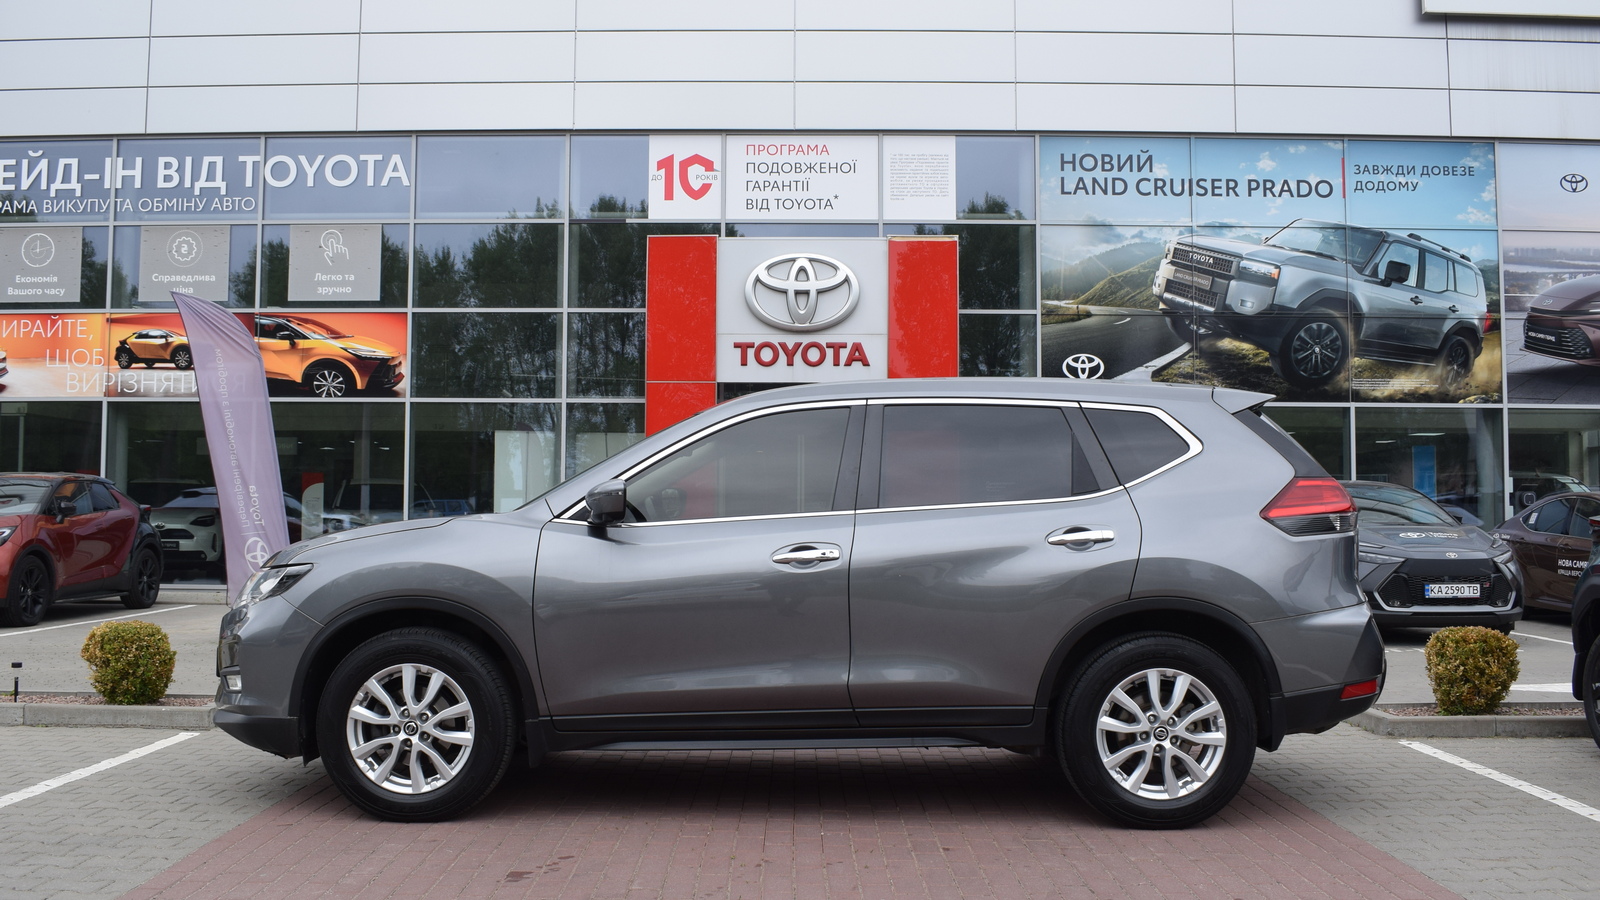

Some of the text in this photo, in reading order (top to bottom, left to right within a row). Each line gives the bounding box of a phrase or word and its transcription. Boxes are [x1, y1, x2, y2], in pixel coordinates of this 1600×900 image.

[745, 144, 830, 156] ПРОГРАМА
[745, 159, 858, 176] ПОДОВЖЕНОЇ
[1060, 149, 1153, 173] НОВИЙ
[0, 150, 411, 197] ЕЙД-ІН ВІД TOYOTA
[1353, 164, 1475, 178] ЗАВЖДИ ДОВЕЗЕ
[745, 177, 811, 192] ГАРАНТІЇ
[1060, 176, 1334, 198] LAND CRUISER PRADO
[1353, 180, 1419, 193] ДОДОМУ
[43, 198, 110, 214] ВИКУПУ
[115, 198, 134, 212] ТА
[138, 197, 207, 212] ОБМІНУ
[210, 196, 256, 211] АВТО
[745, 198, 770, 212] ВІД
[1189, 252, 1214, 264] TOYOTA
[15, 274, 58, 283] Економія
[152, 273, 216, 283] Справедлива
[314, 272, 343, 281] Легко
[7, 286, 66, 297] Вашого часу
[317, 286, 352, 295] зручно
[2, 315, 94, 340] ИРАЙТЕ,
[45, 348, 105, 370] ЩОБ
[733, 341, 870, 367] TOYOTA
[1444, 585, 1465, 595] 2590
